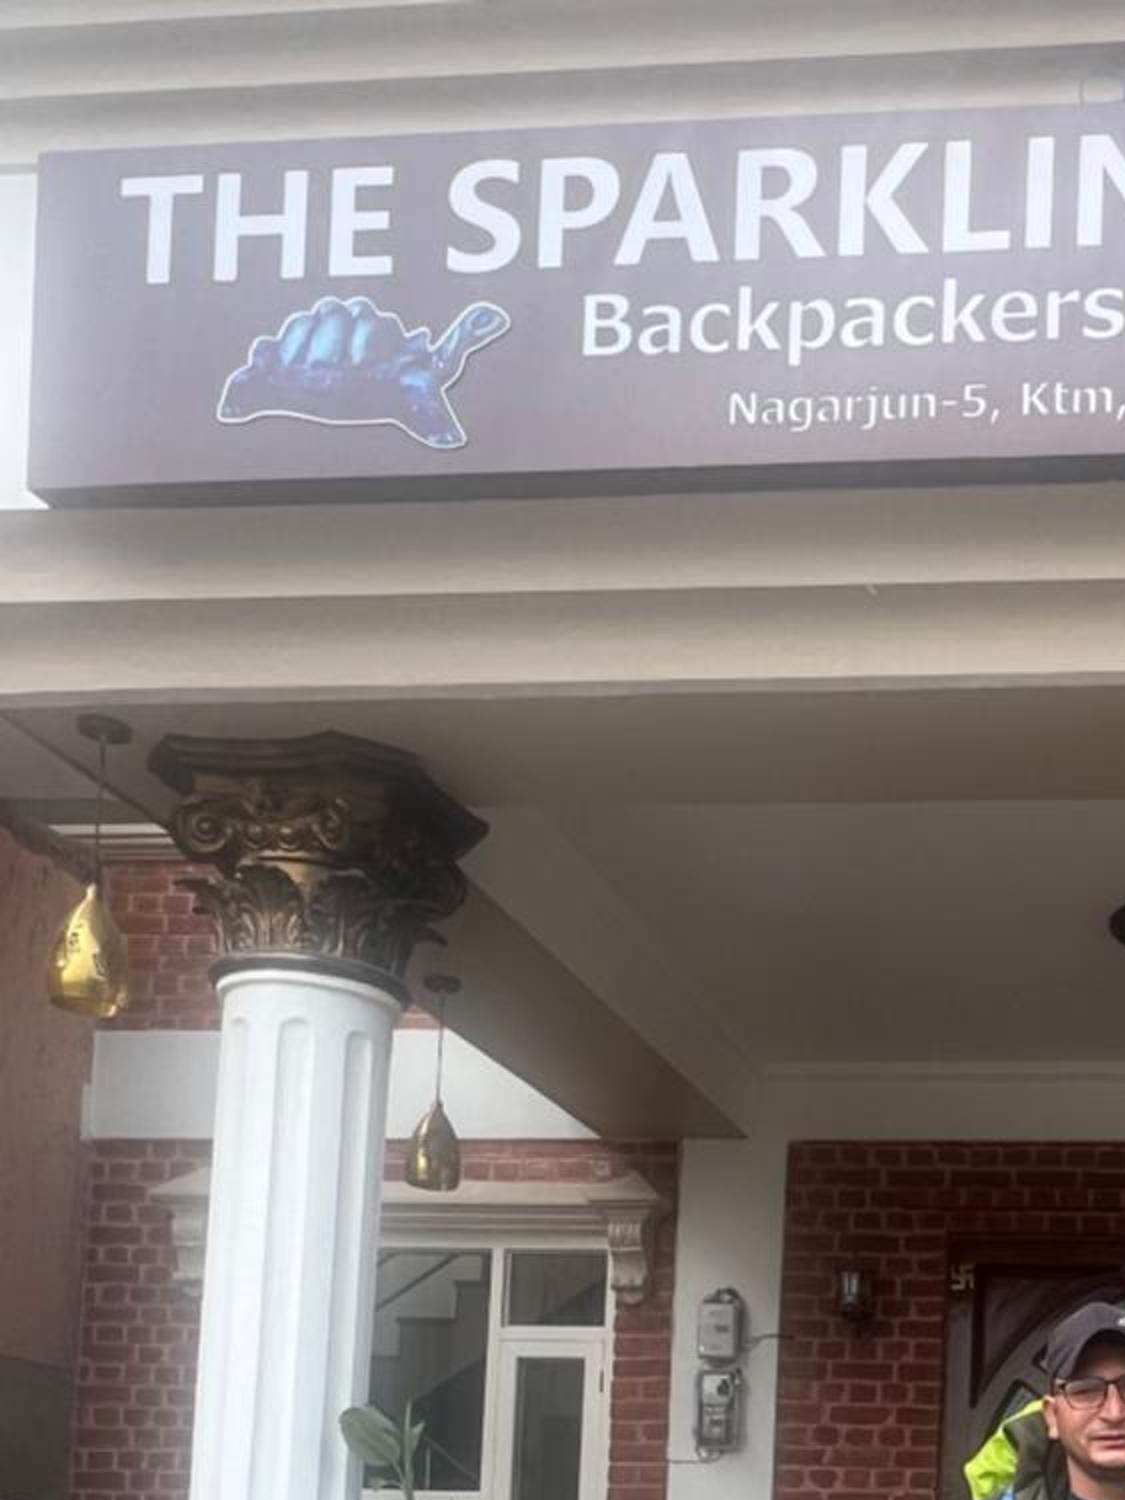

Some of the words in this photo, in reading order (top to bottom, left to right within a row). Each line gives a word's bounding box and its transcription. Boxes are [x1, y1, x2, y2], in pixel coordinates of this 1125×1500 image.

[121, 166, 394, 283] THE
[582, 278, 1125, 366] Backpackers
[729, 383, 1000, 432] Nagarjun-5,
